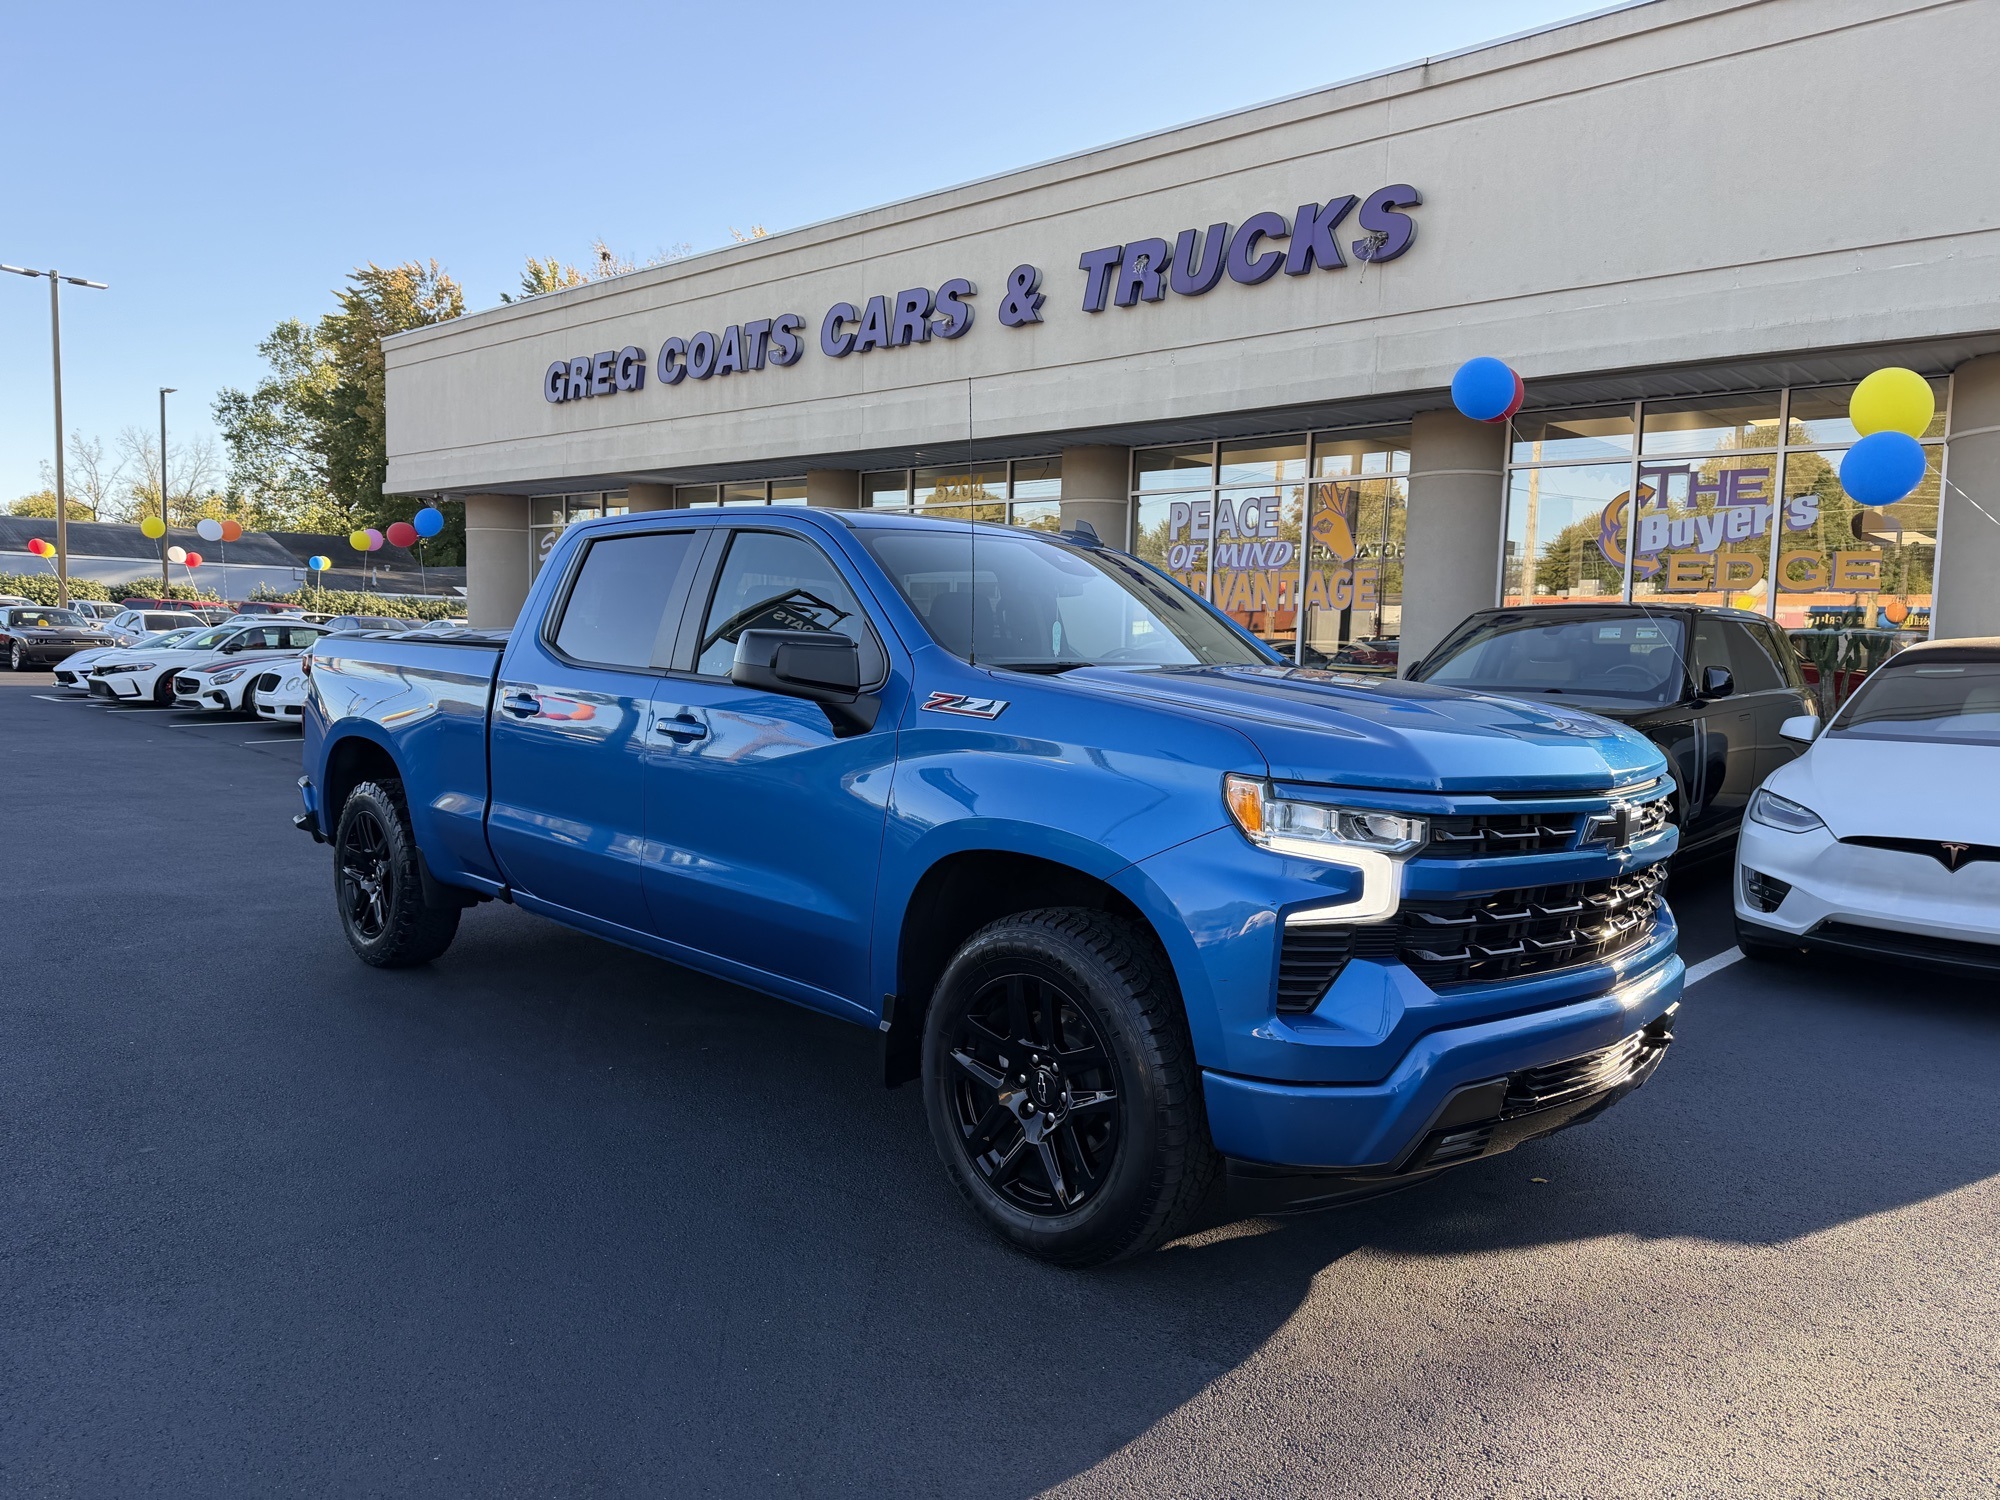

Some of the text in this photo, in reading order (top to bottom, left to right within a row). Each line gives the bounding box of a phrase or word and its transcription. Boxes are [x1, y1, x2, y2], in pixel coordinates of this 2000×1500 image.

[544, 184, 1422, 404] GREG COATS CARS & TRUCKS
[935, 474, 985, 502] 5204
[1637, 464, 1770, 512] THE
[1169, 495, 1282, 542] PEACE
[1636, 492, 1819, 554] Buyer's
[1168, 544, 1207, 570] OF
[1213, 541, 1294, 570] MIND
[1665, 549, 1883, 593] EDGE
[920, 691, 1010, 721] Z71
